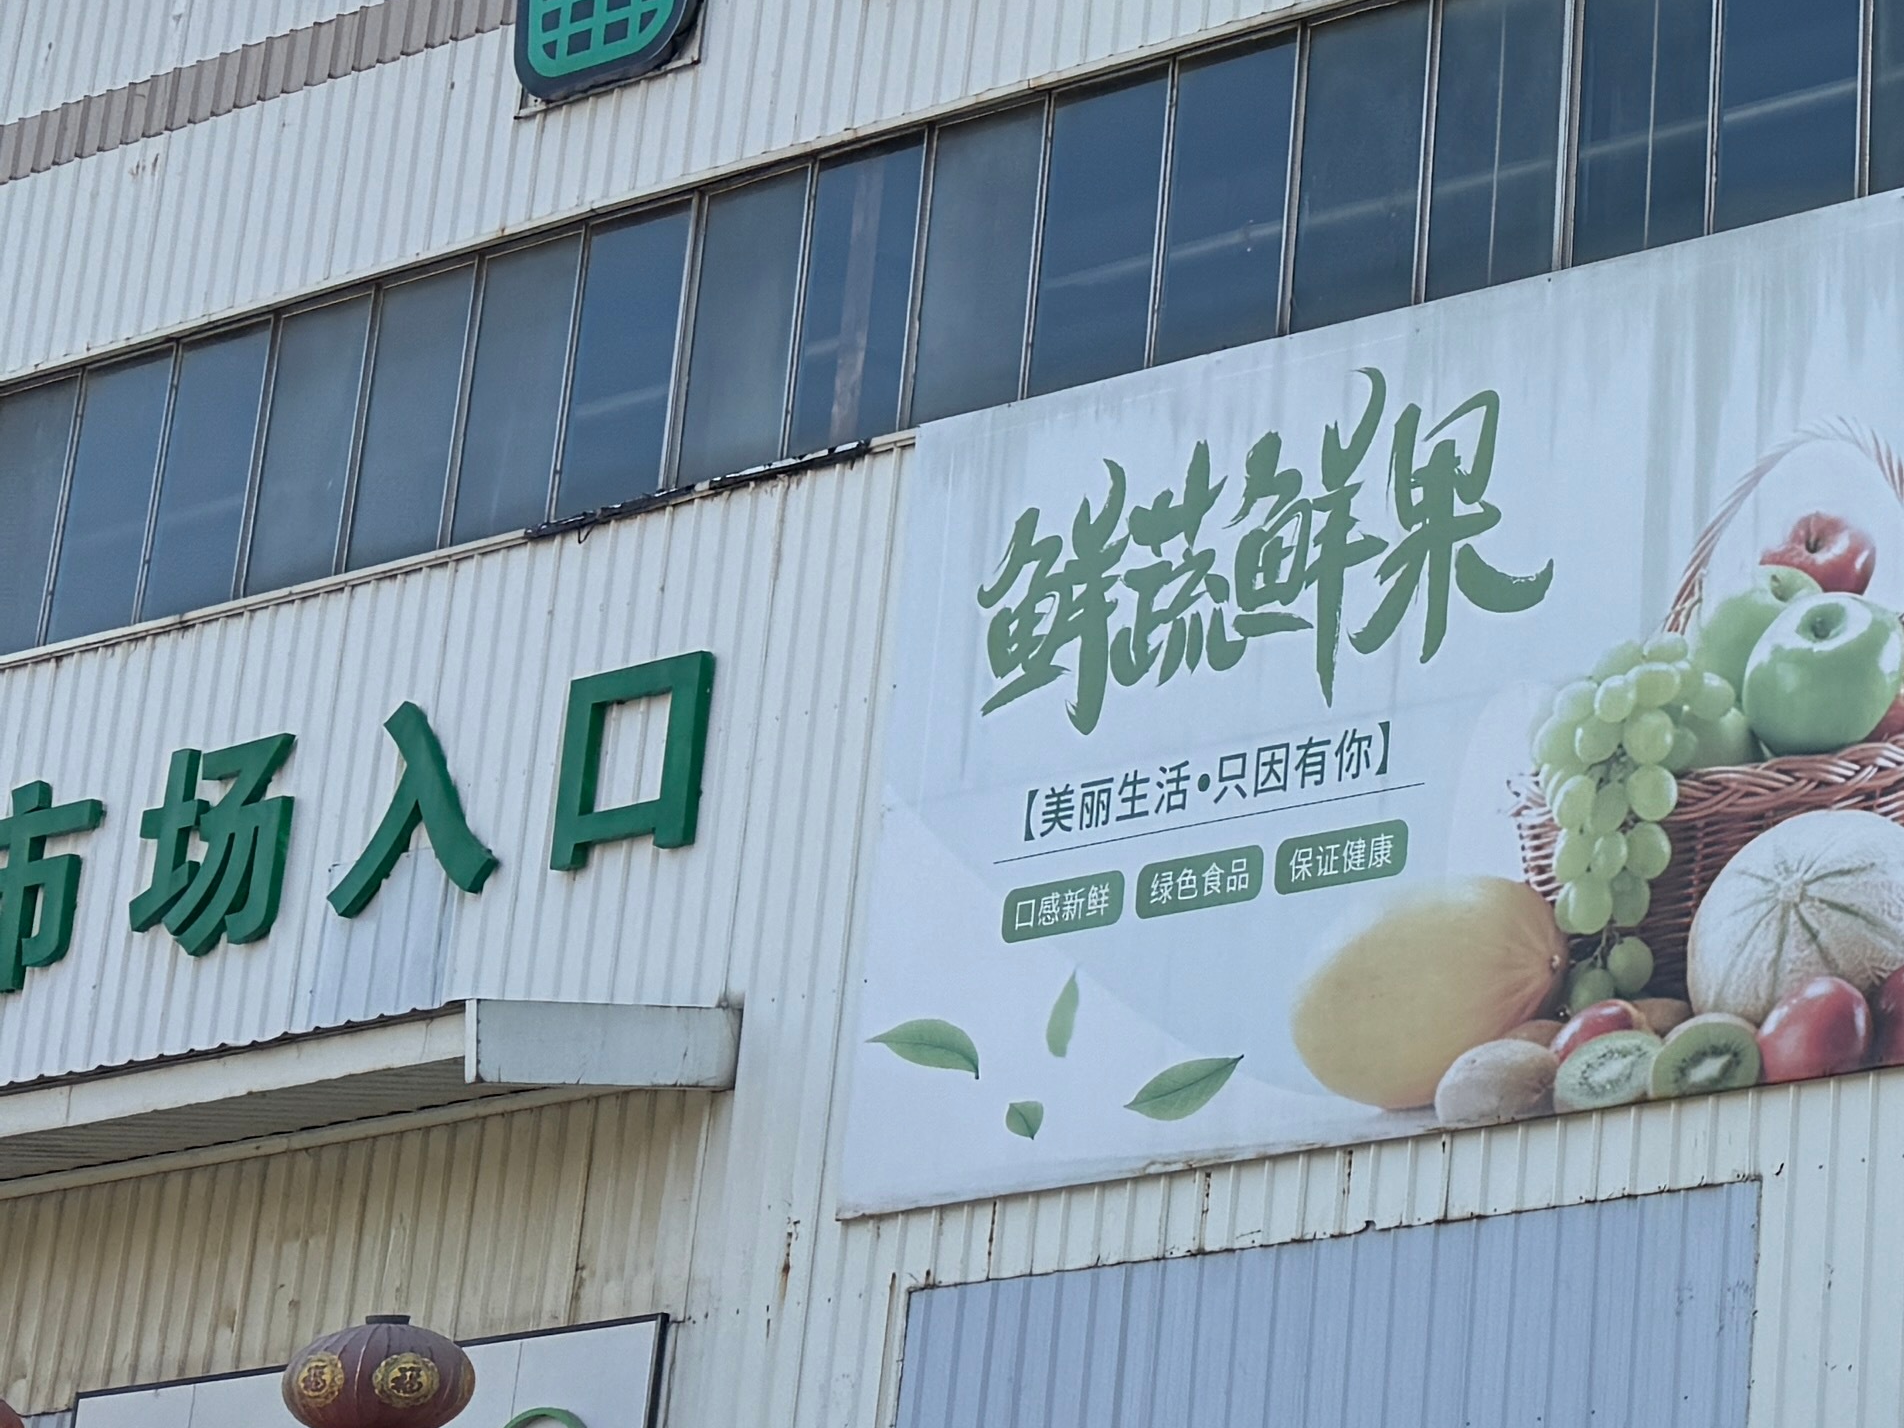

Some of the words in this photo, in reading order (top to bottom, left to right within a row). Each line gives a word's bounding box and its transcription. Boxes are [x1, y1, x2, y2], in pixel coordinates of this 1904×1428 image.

[977, 367, 1554, 736] 鲜蔬鲜果
[0, 650, 715, 992] 市场入口
[1149, 857, 1249, 904] 绿色食品
[1289, 833, 1394, 882] 保证健康
[1014, 882, 1110, 930] 口感新鲜
